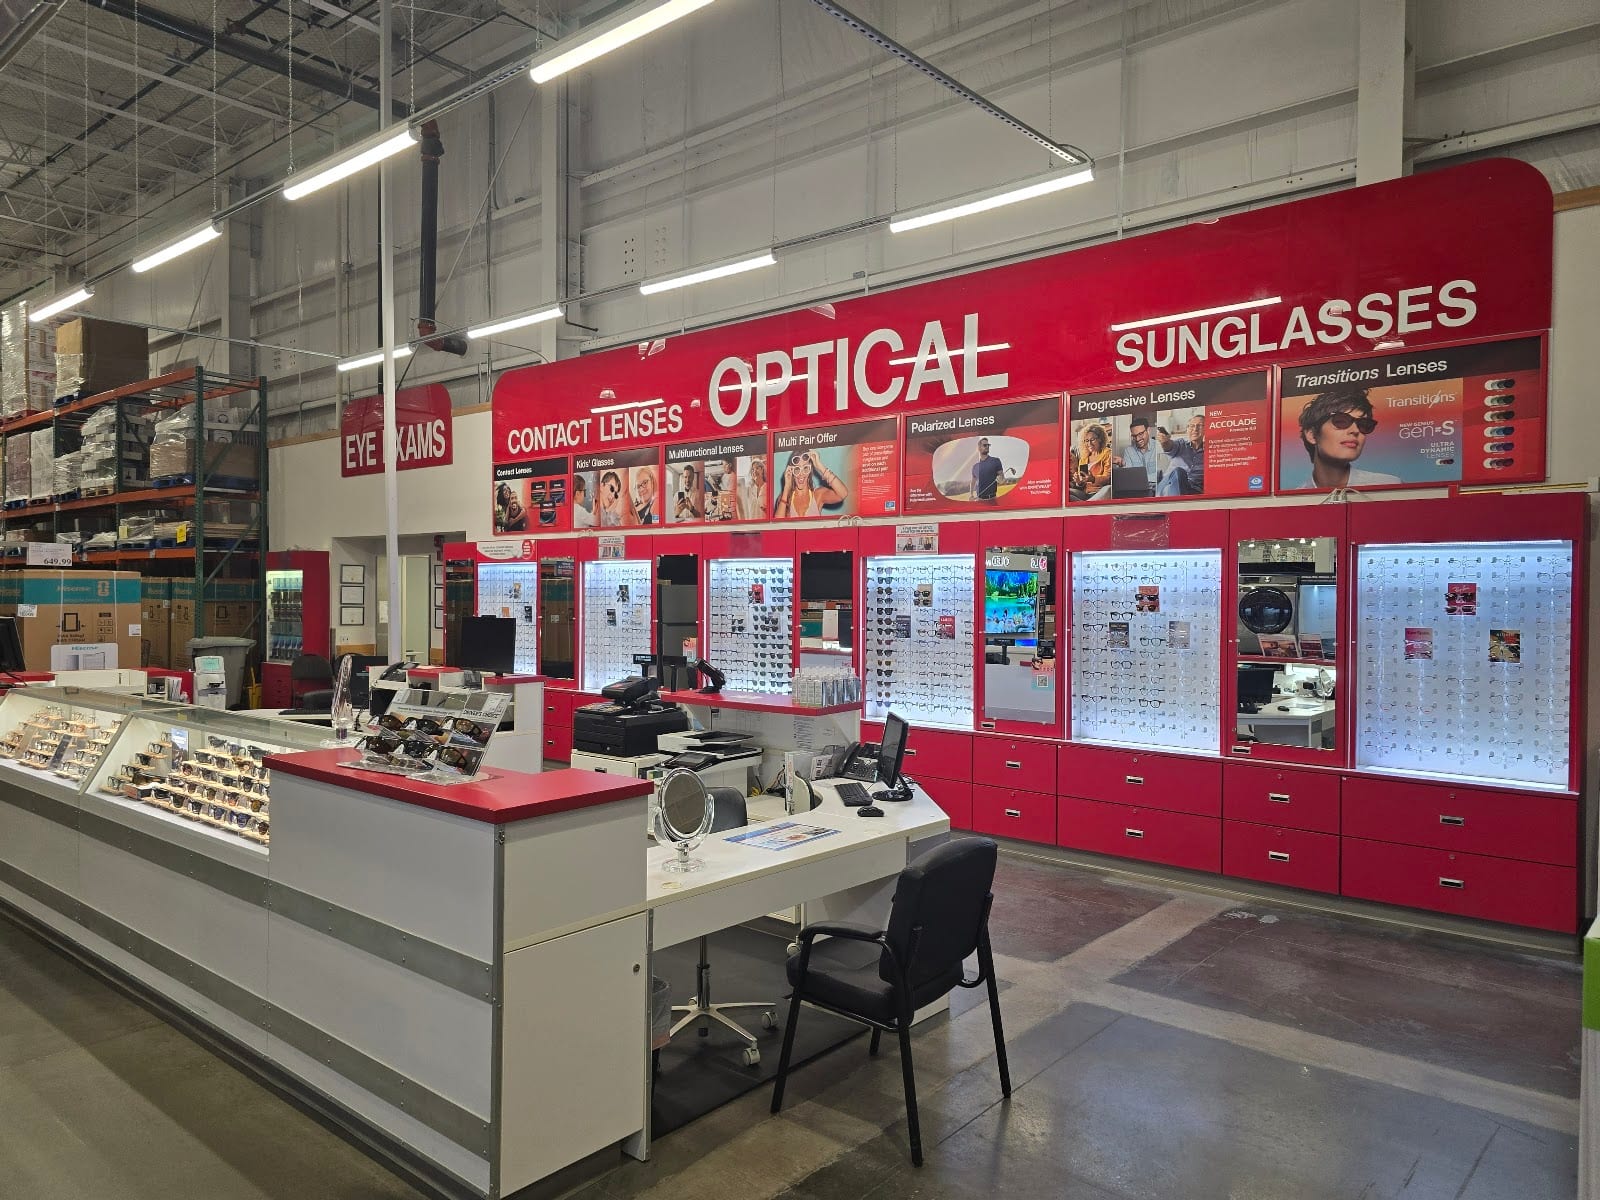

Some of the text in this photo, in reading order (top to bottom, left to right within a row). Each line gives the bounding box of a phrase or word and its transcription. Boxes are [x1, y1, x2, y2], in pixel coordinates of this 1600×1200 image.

[1115, 279, 1477, 373] SUNGLASSES
[709, 312, 1009, 428] OPTICAL
[1296, 360, 1448, 388] Transitions Lenses
[1078, 389, 1196, 413] Progressive Lenses
[1385, 389, 1456, 409] Transitions
[507, 404, 683, 454] CONTACT LENSES
[911, 415, 995, 433] Polarized Lenses
[1209, 417, 1257, 430] ACCOLADE
[345, 418, 446, 469] EYE XAMS
[778, 432, 838, 448] Multi Pair Offer
[668, 444, 745, 460] Multifunctional Lenses
[1420, 446, 1455, 454] DYNAMIC
[496, 467, 533, 477] Contact Lenses
[576, 458, 615, 469] Kids' Glasses
